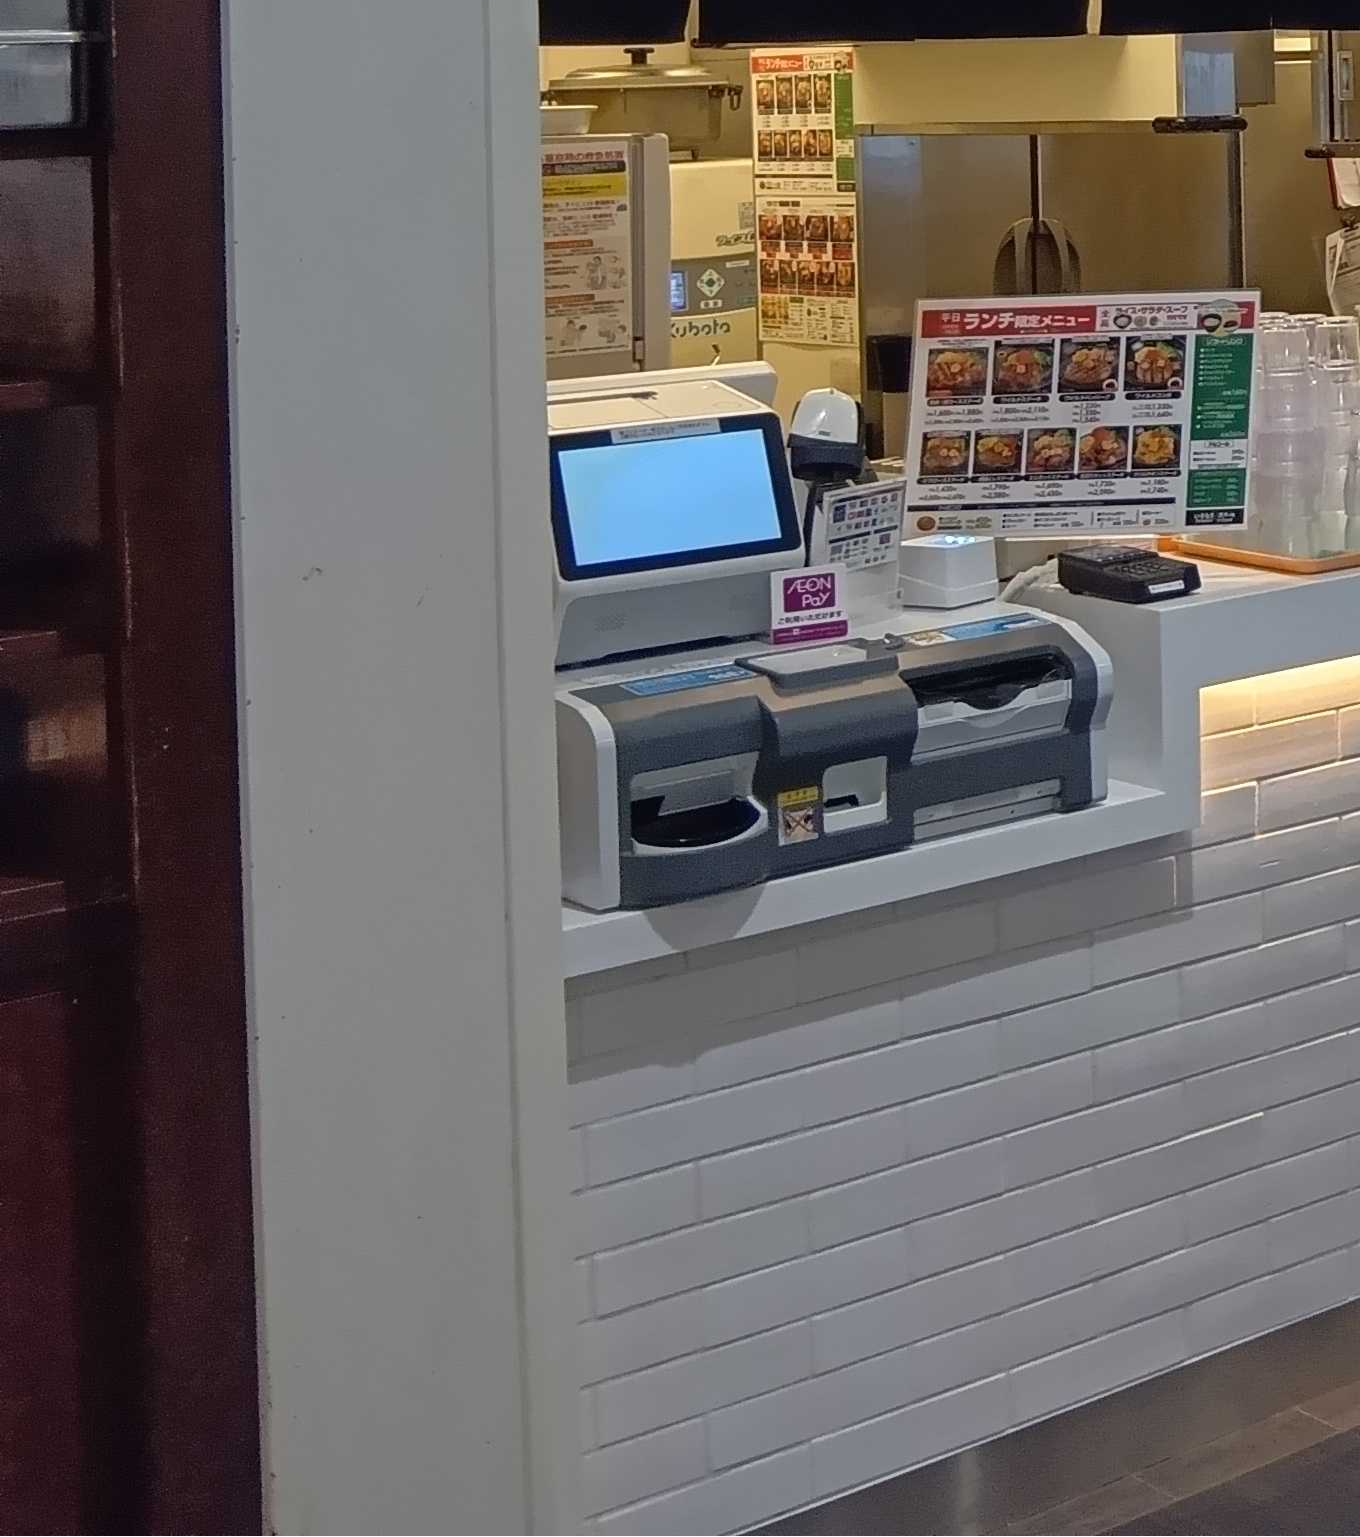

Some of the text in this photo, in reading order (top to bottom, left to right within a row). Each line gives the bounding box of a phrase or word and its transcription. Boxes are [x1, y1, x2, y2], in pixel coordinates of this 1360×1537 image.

[963, 312, 1092, 331] ランチ限定メニュー
[801, 591, 831, 608] Pay
